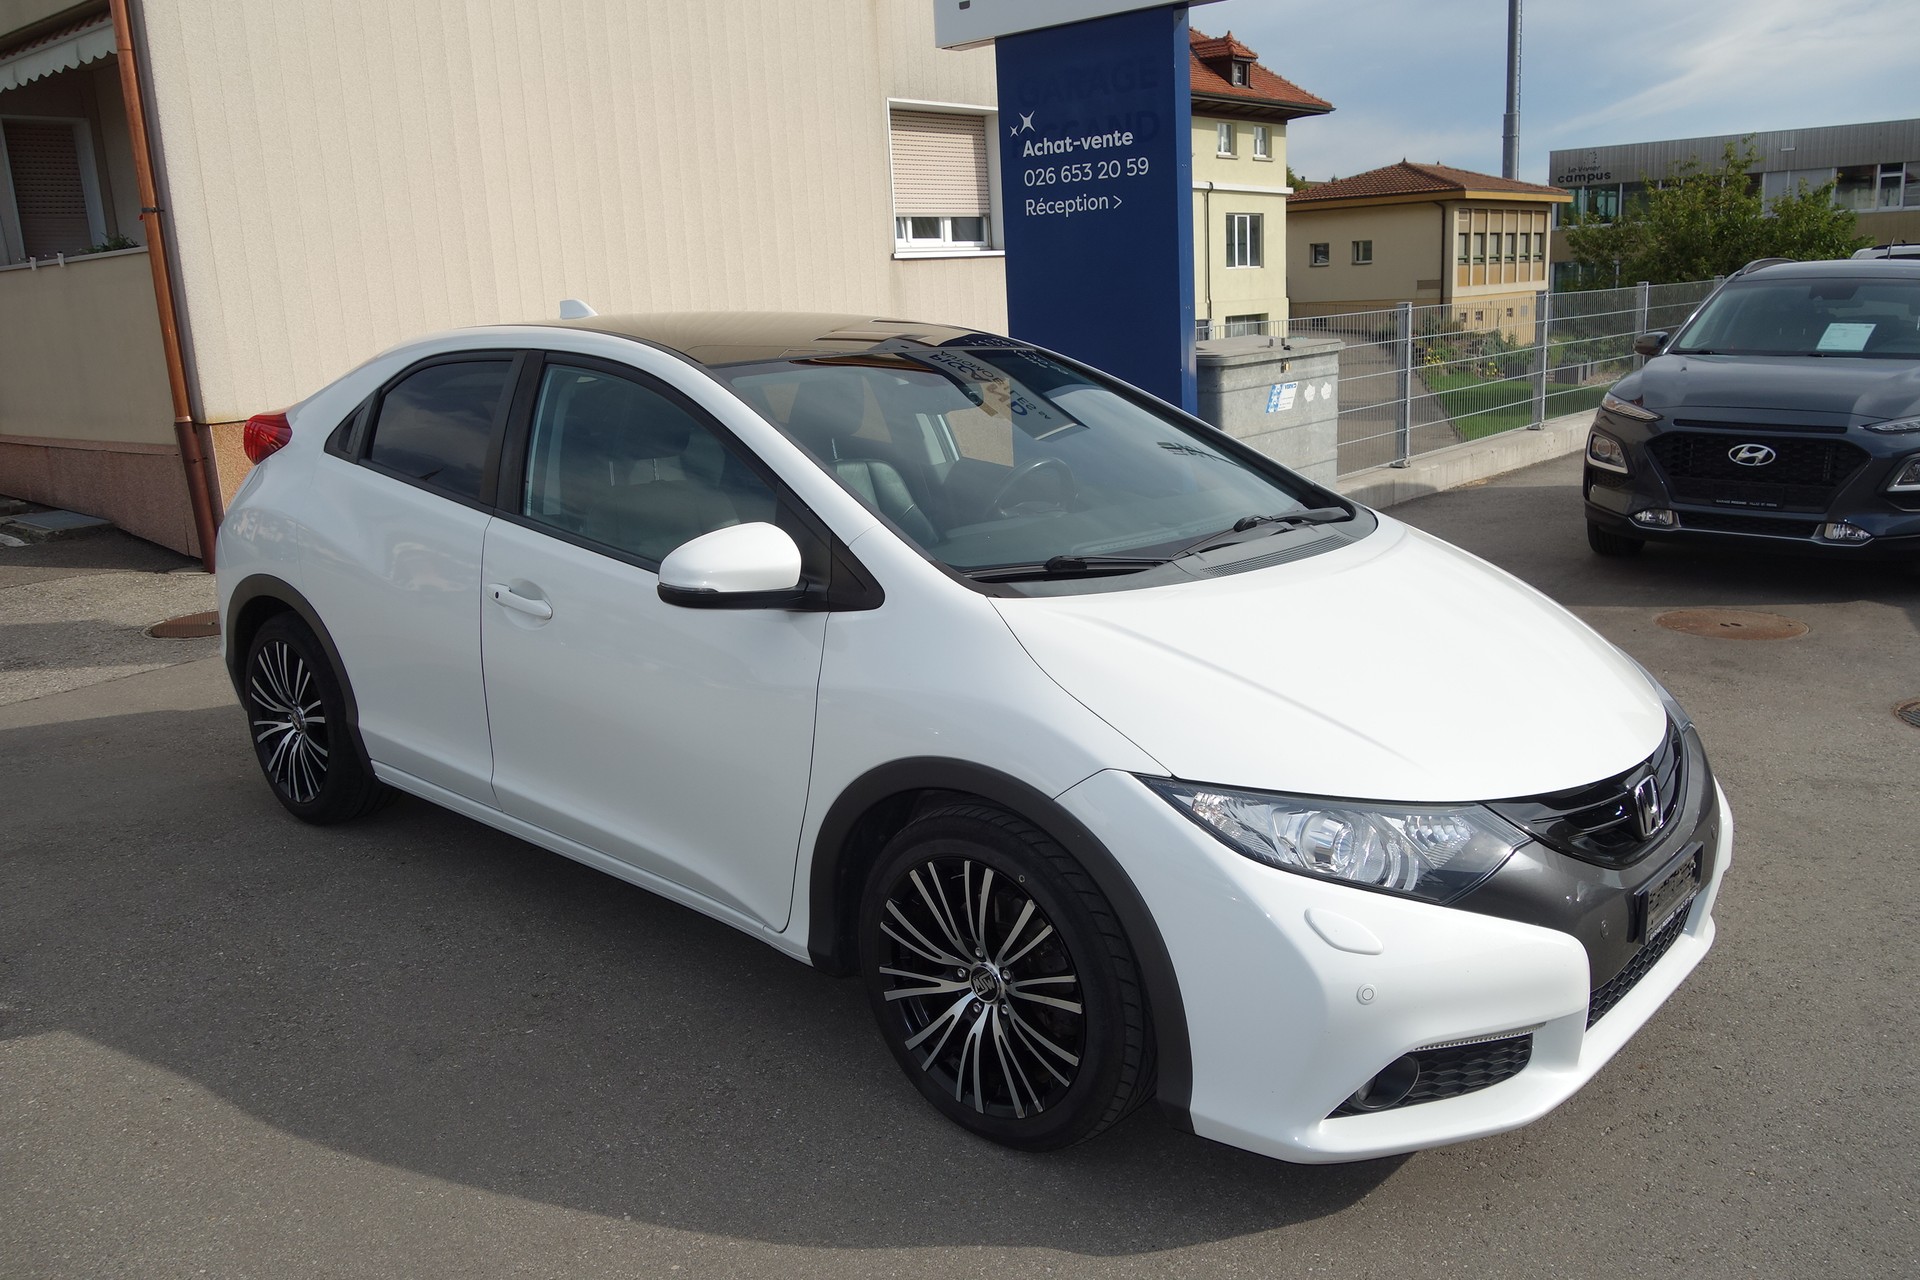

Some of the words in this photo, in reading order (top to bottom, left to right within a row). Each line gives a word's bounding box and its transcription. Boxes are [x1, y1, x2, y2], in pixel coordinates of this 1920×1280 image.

[1023, 130, 1134, 158] Achat-vente
[1024, 167, 1056, 187] 026
[1061, 162, 1093, 183] 653
[1097, 160, 1121, 180] 20
[1126, 157, 1150, 176] 59
[1558, 172, 1611, 183] campus
[1025, 193, 1109, 217] Réception
